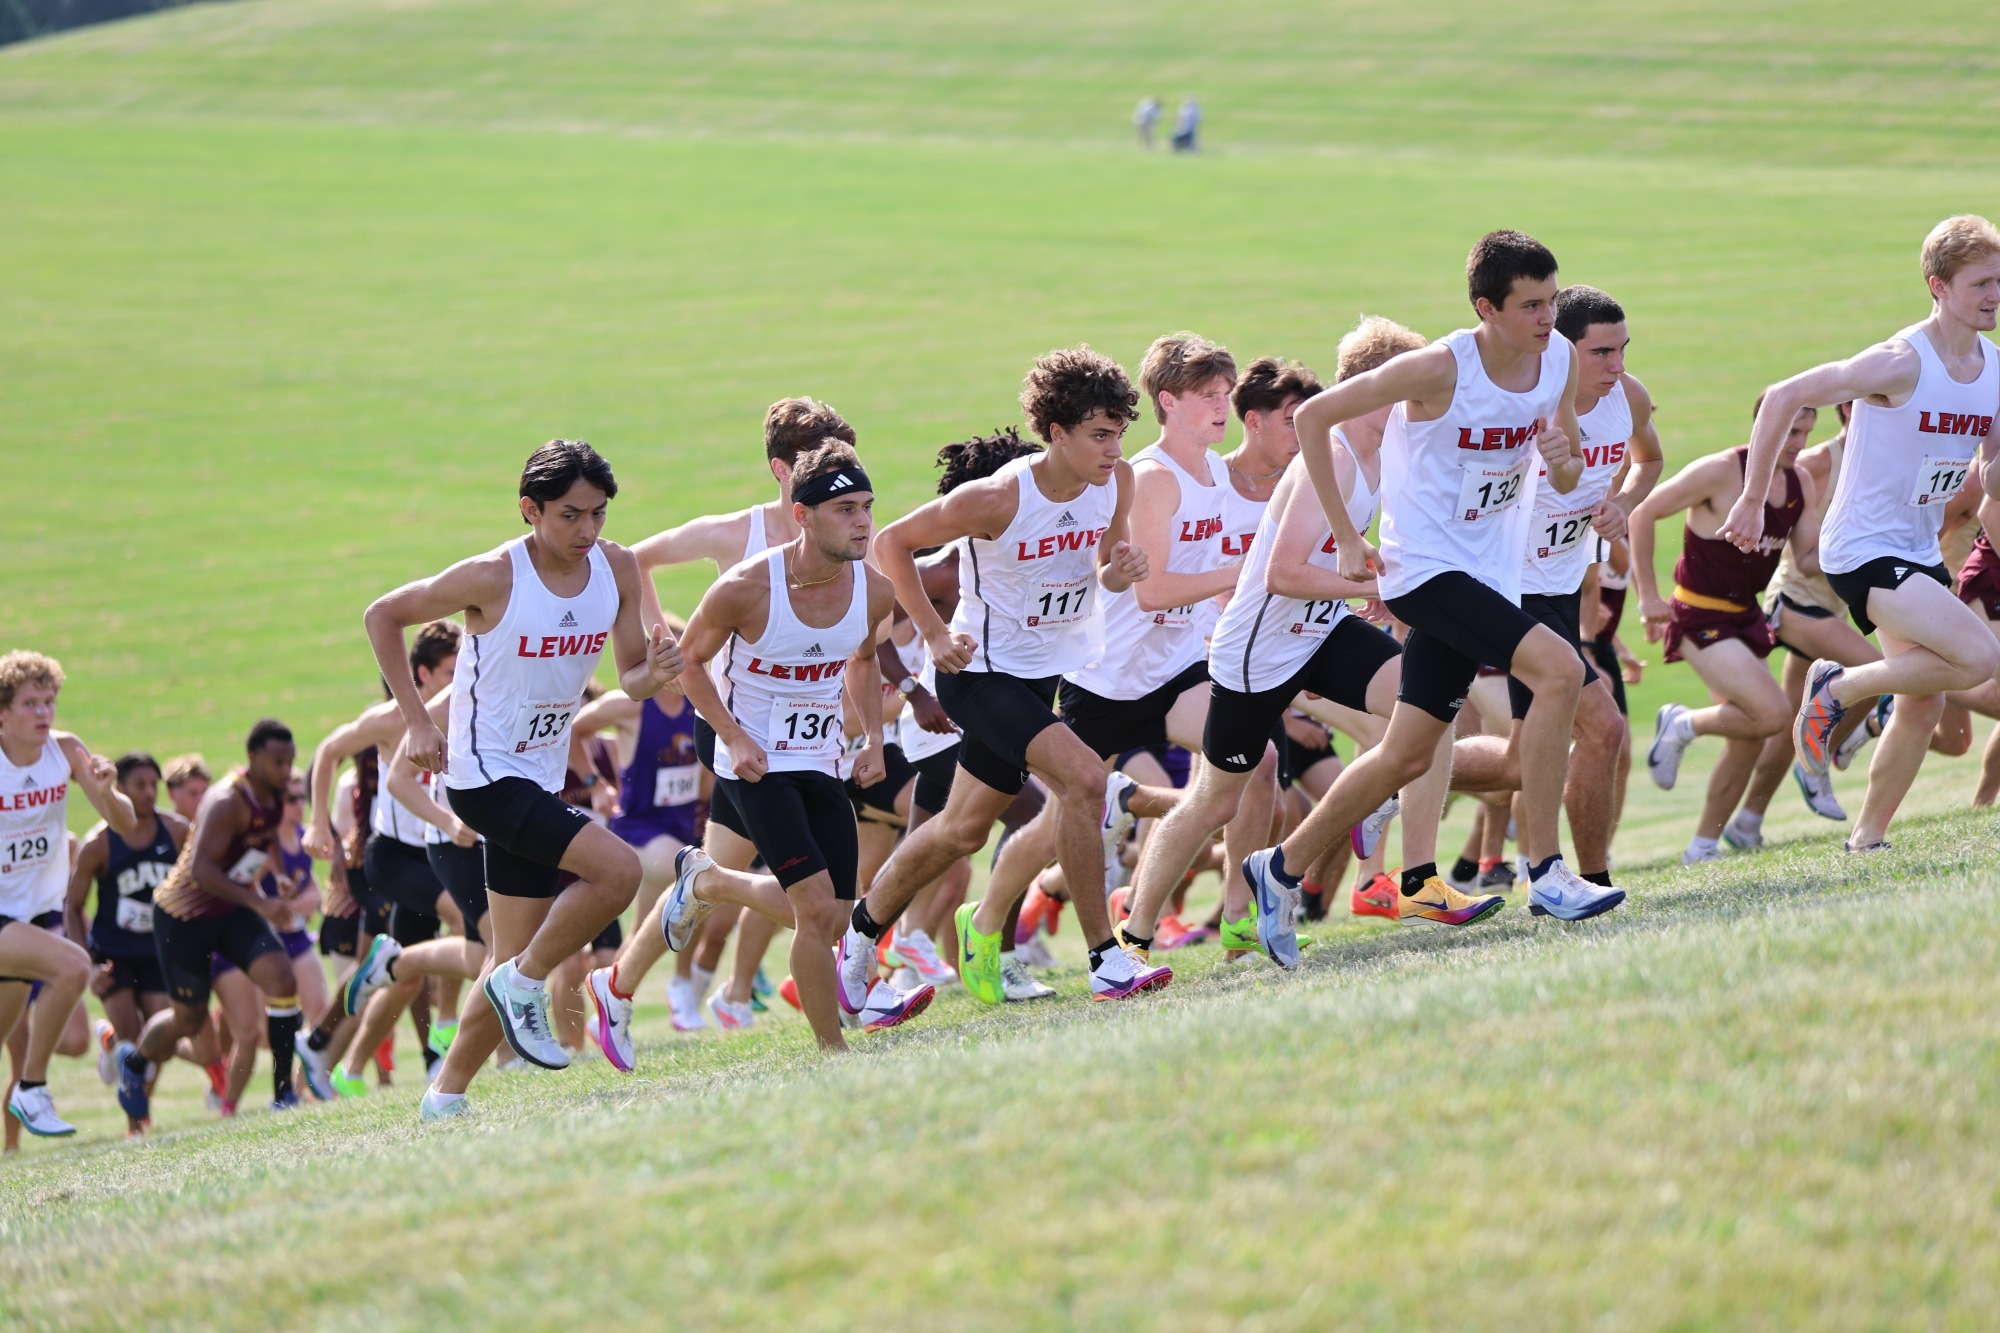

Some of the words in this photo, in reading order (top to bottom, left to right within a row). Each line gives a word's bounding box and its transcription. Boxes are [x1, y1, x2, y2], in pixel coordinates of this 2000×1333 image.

[1478, 474, 1520, 508] 132
[1930, 469, 1967, 494] 119
[1056, 520, 1078, 528] adidas
[1545, 514, 1593, 547] 127
[1039, 586, 1088, 616] 117
[518, 631, 608, 658] LEWIS
[529, 712, 571, 741] 133
[785, 712, 836, 740] 130
[0, 783, 67, 811] LEWIS
[7, 836, 48, 863] 129
